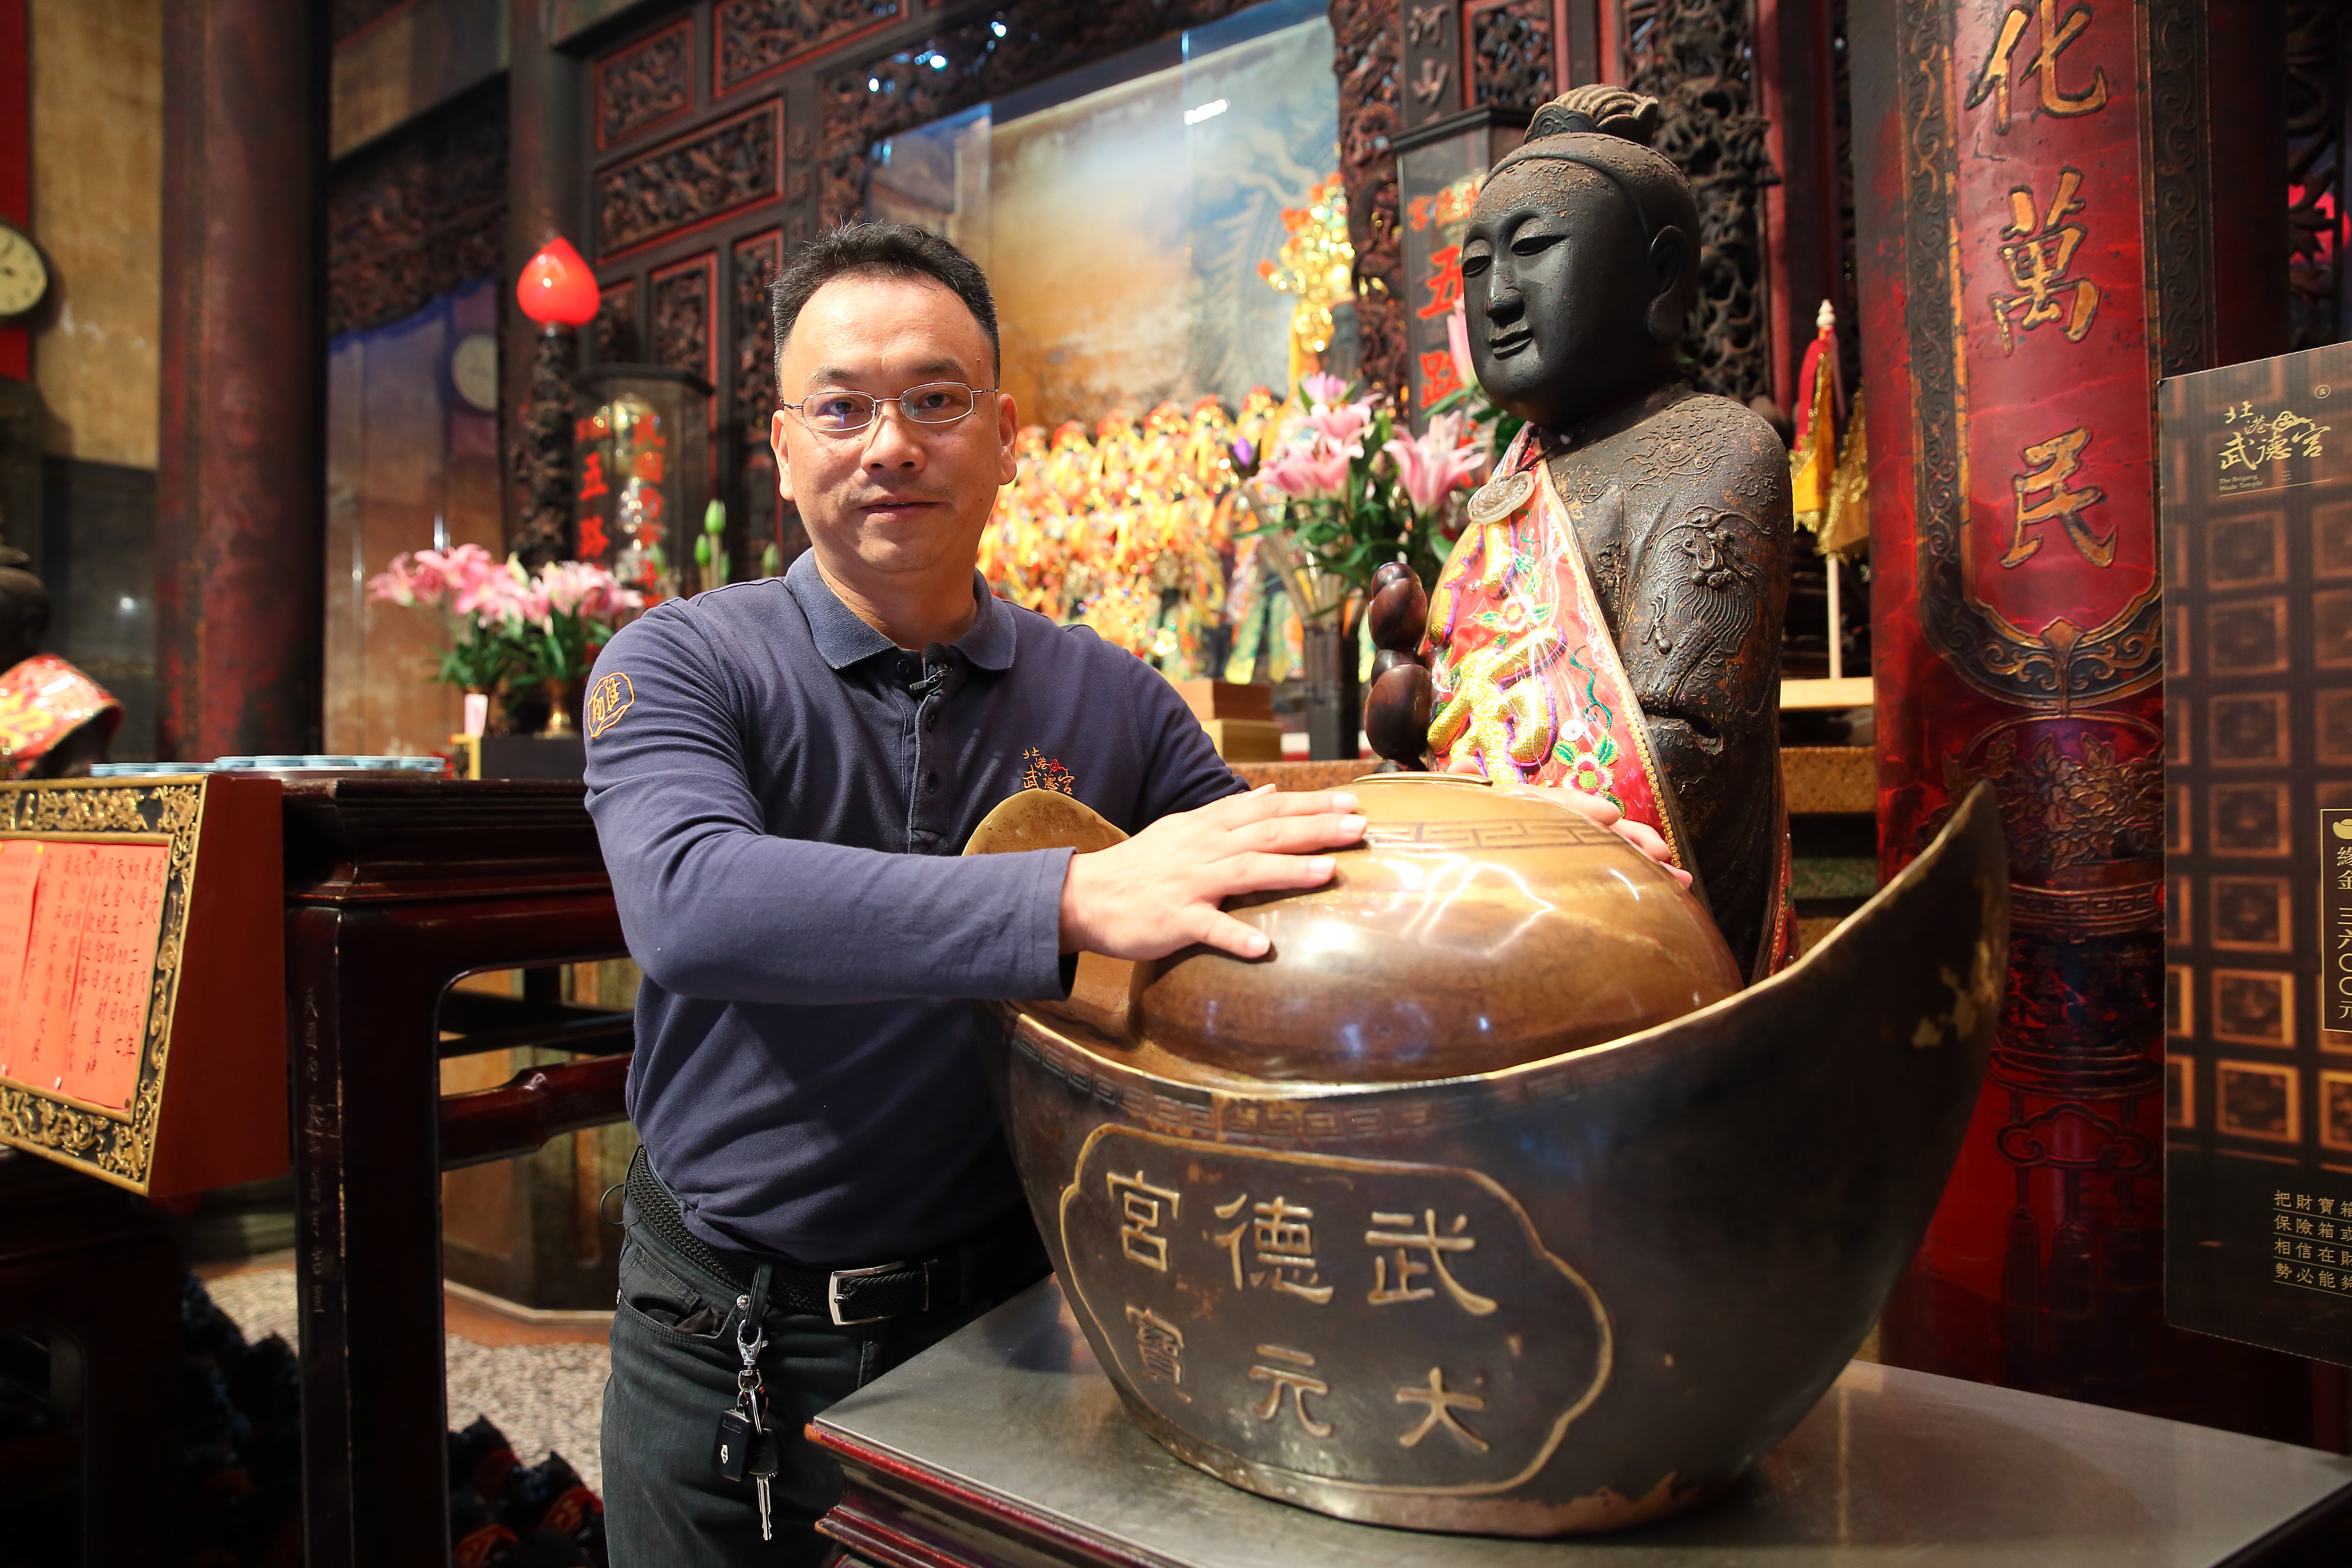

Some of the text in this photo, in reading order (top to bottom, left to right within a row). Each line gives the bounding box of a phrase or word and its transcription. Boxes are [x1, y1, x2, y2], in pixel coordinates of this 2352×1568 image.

[2224, 400, 2270, 434] 北港
[2218, 423, 2331, 470] 武德宮
[1022, 746, 1050, 770] 北港
[1022, 764, 1075, 795] 武德宮
[2274, 1189, 2352, 1218] 把財寶箱
[1106, 1169, 1497, 1314] 武德宮
[2274, 1214, 2352, 1241] 保險箱或
